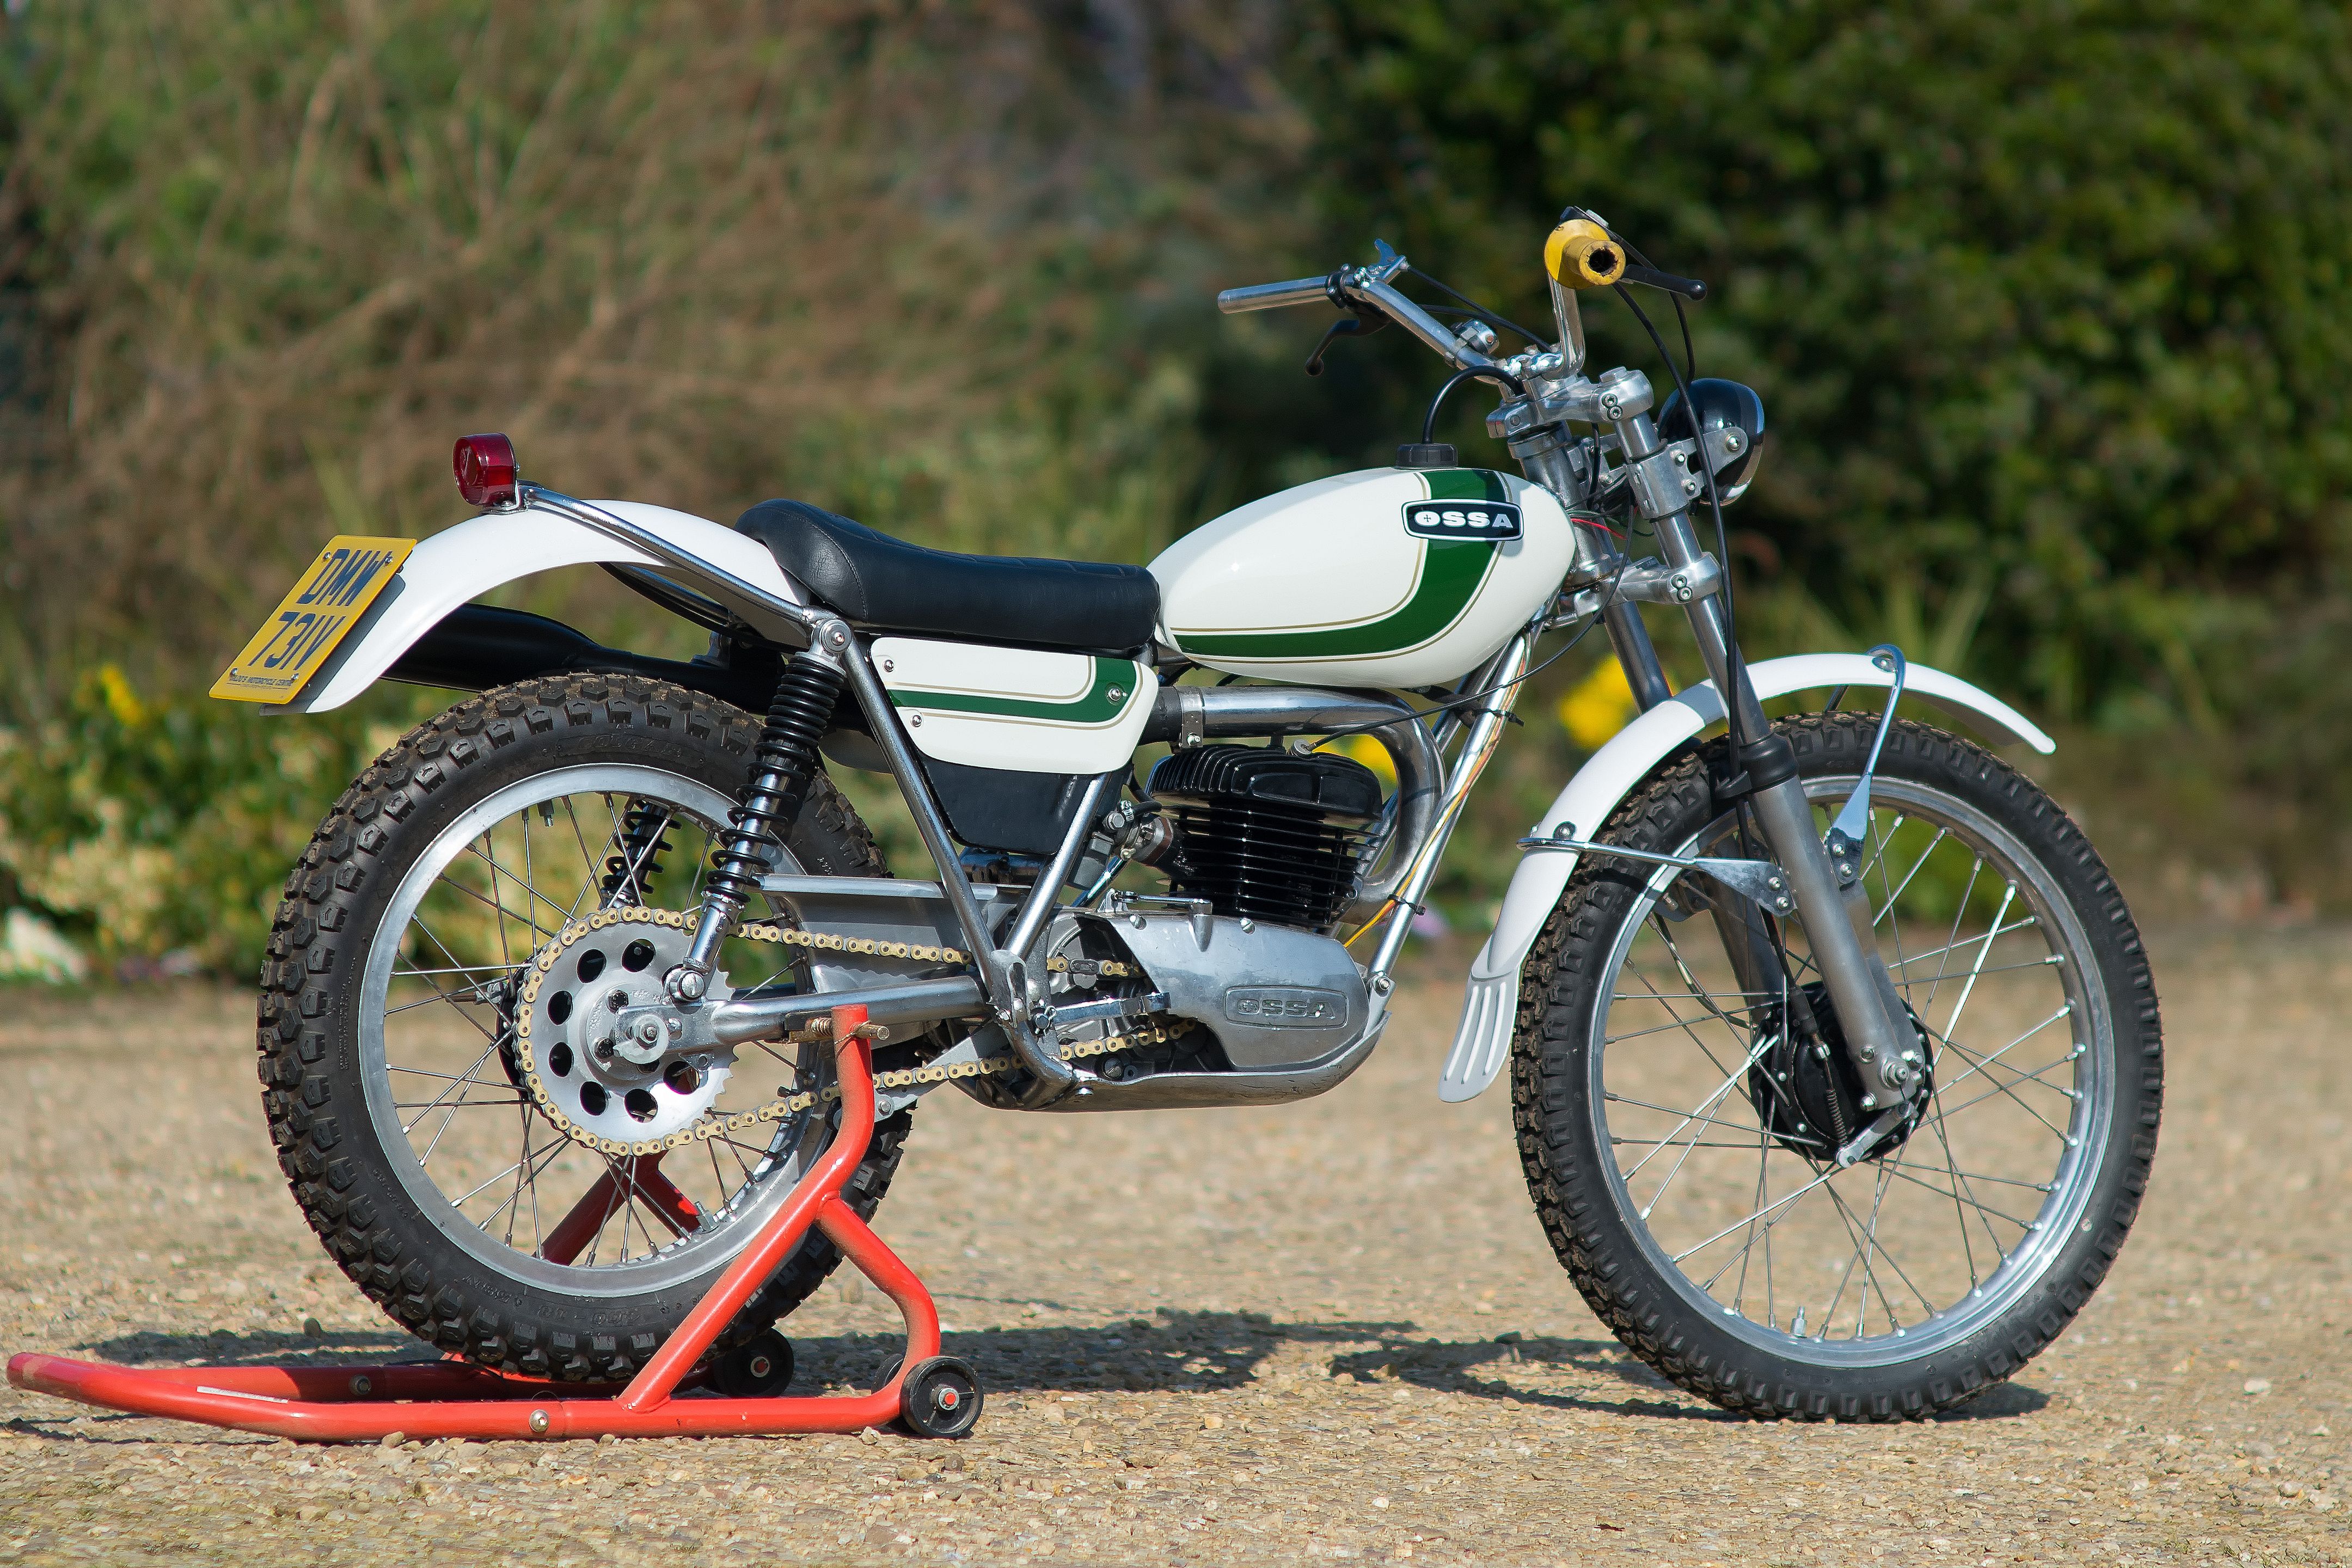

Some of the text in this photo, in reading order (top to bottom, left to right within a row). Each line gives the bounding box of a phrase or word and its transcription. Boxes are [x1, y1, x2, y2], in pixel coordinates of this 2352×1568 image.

[1414, 510, 1514, 528] OSSA
[296, 548, 393, 607] DMW
[248, 611, 346, 671] 731V
[1238, 999, 1336, 1019] OSSA
